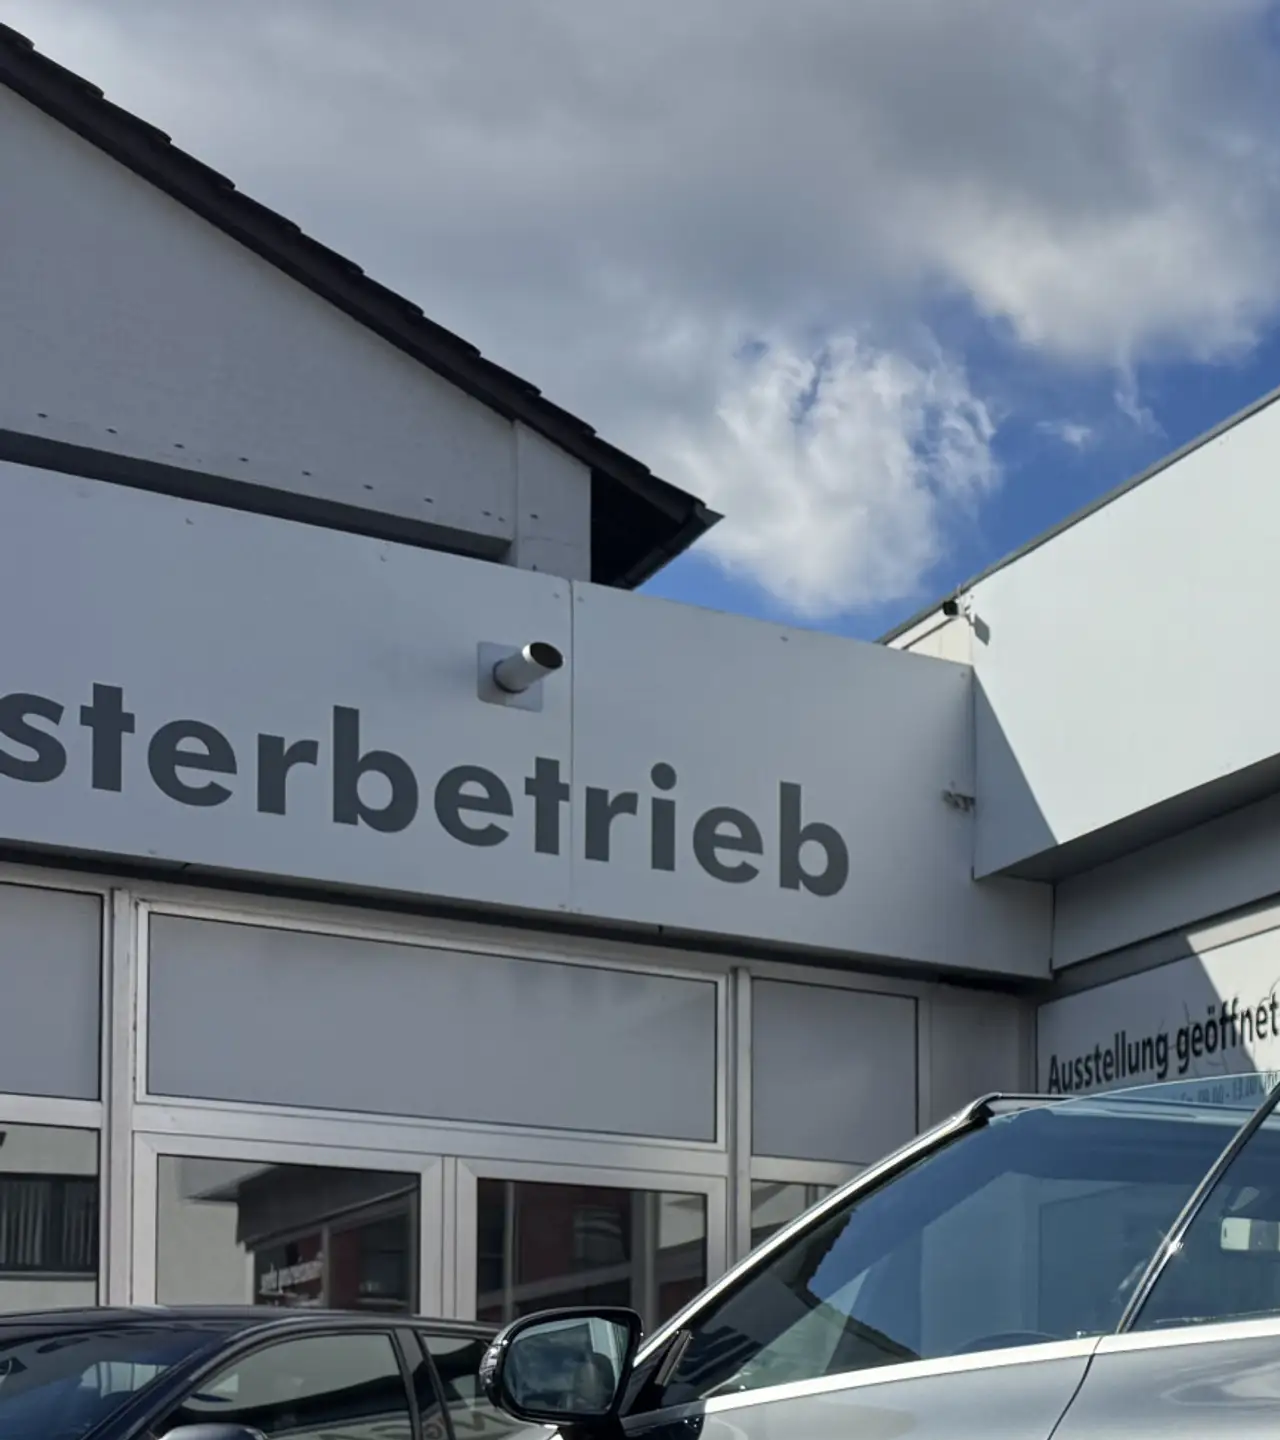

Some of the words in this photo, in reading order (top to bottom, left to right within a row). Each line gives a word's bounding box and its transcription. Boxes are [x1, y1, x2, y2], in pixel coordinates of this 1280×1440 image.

[0, 683, 850, 897] sterbetrieb
[1047, 1030, 1170, 1096] Ausstellung
[1175, 991, 1280, 1075] geöffnet
